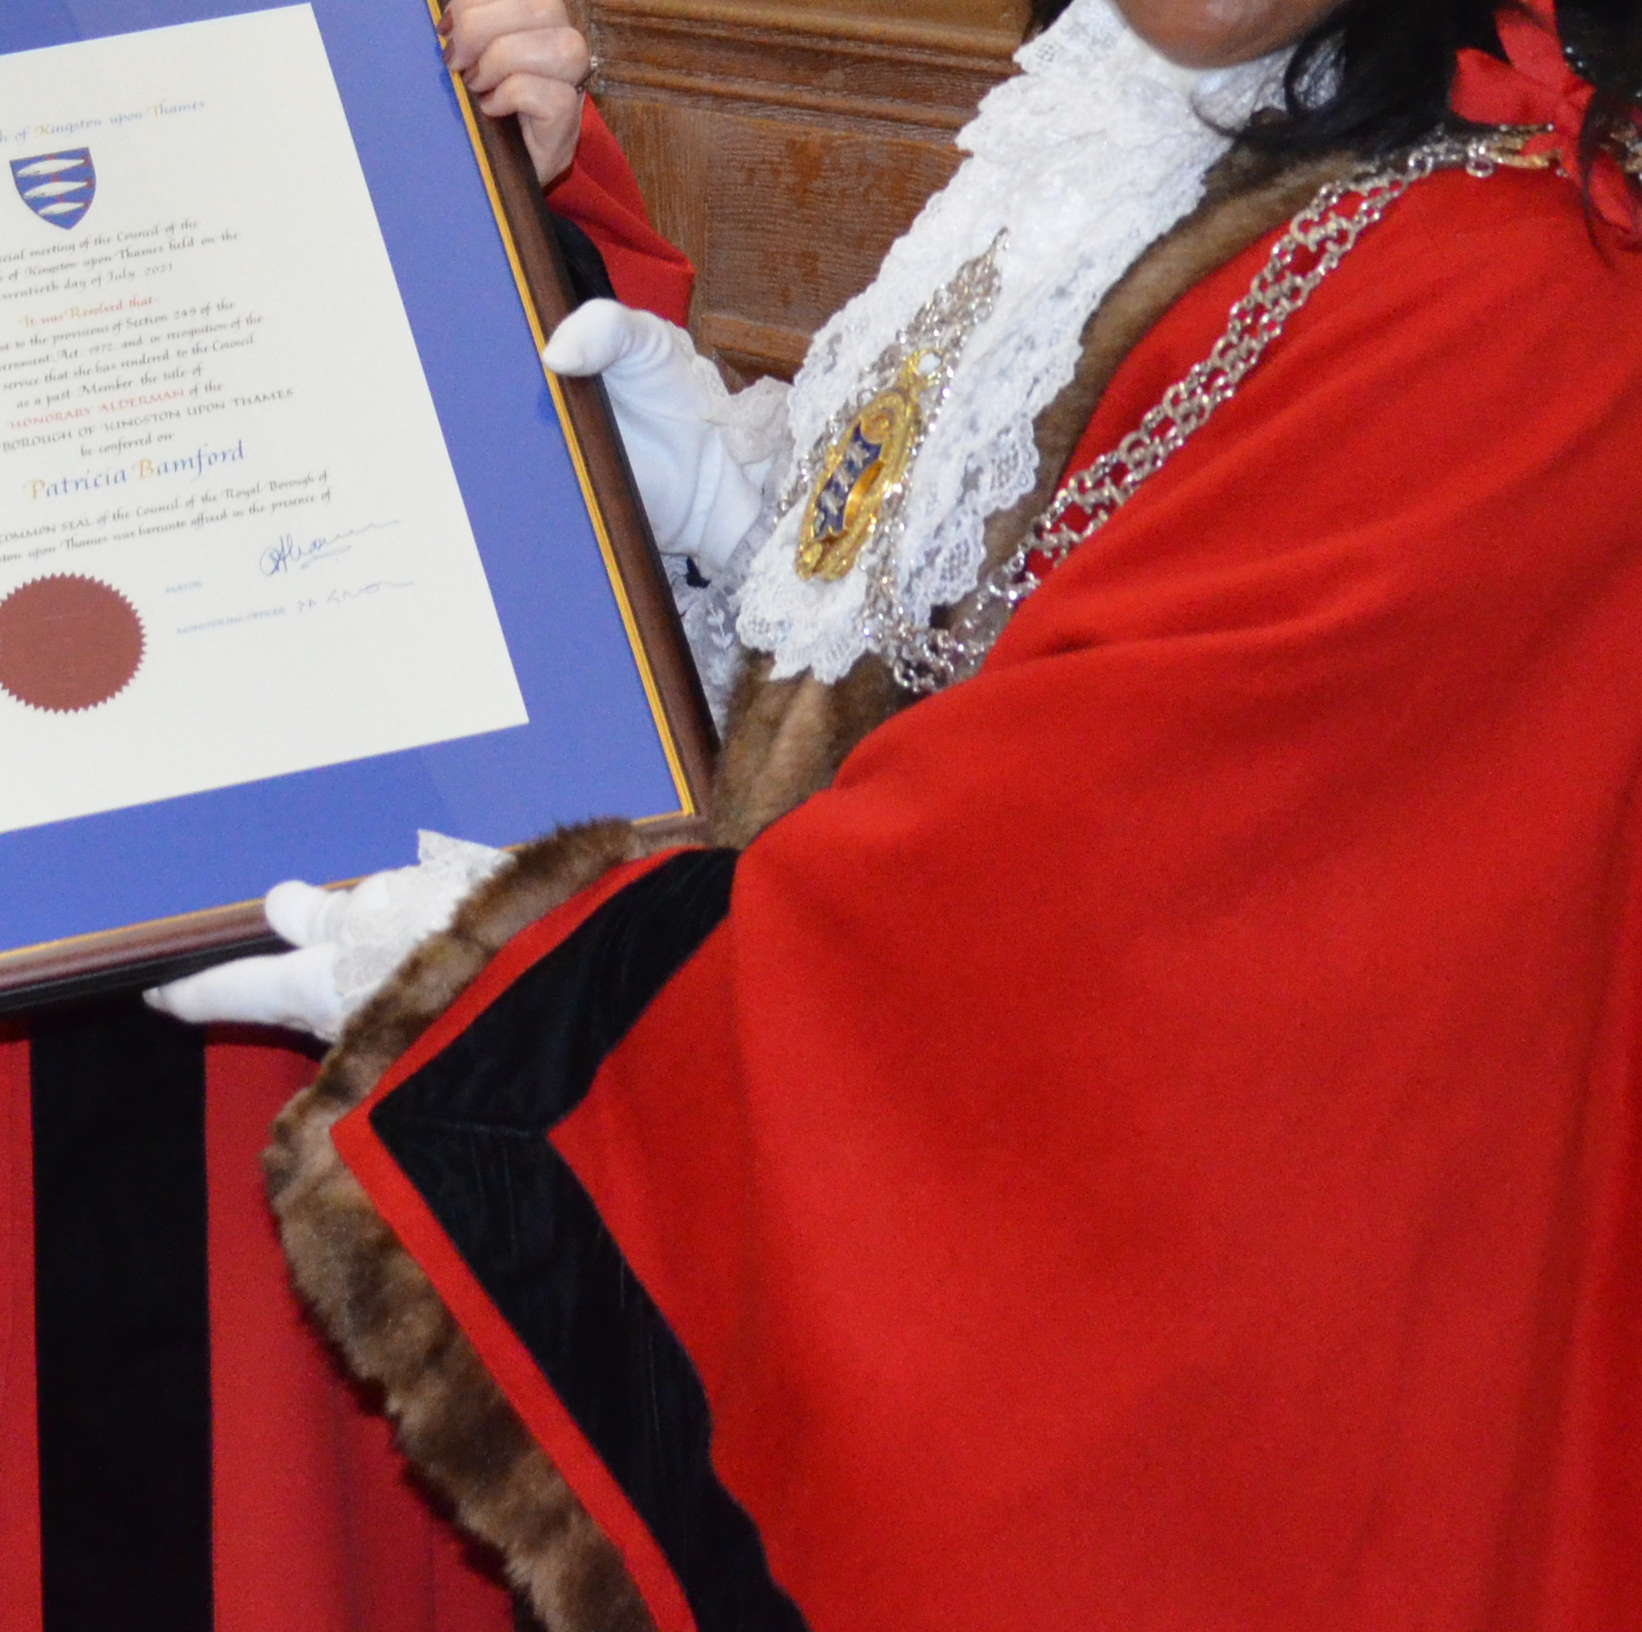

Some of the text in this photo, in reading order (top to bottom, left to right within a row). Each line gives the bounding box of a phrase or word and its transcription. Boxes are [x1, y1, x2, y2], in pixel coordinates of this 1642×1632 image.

[93, 234, 112, 246] the
[115, 223, 160, 243] Council
[179, 217, 198, 230] the
[220, 228, 238, 242] the
[14, 340, 26, 350] to
[29, 333, 48, 346] the
[215, 299, 234, 312] the
[120, 335, 144, 349] and
[244, 312, 262, 326] the
[43, 370, 69, 383] that
[175, 348, 188, 358] to
[190, 341, 208, 356] the
[211, 332, 254, 352] Council
[33, 397, 42, 406] a
[139, 371, 157, 386] the
[203, 380, 222, 393] the
[29, 438, 244, 500] Patricia Bamford
[111, 508, 129, 522] the
[135, 497, 180, 518] Council
[200, 491, 217, 504] the
[231, 509, 245, 518] in
[247, 502, 265, 515] the
